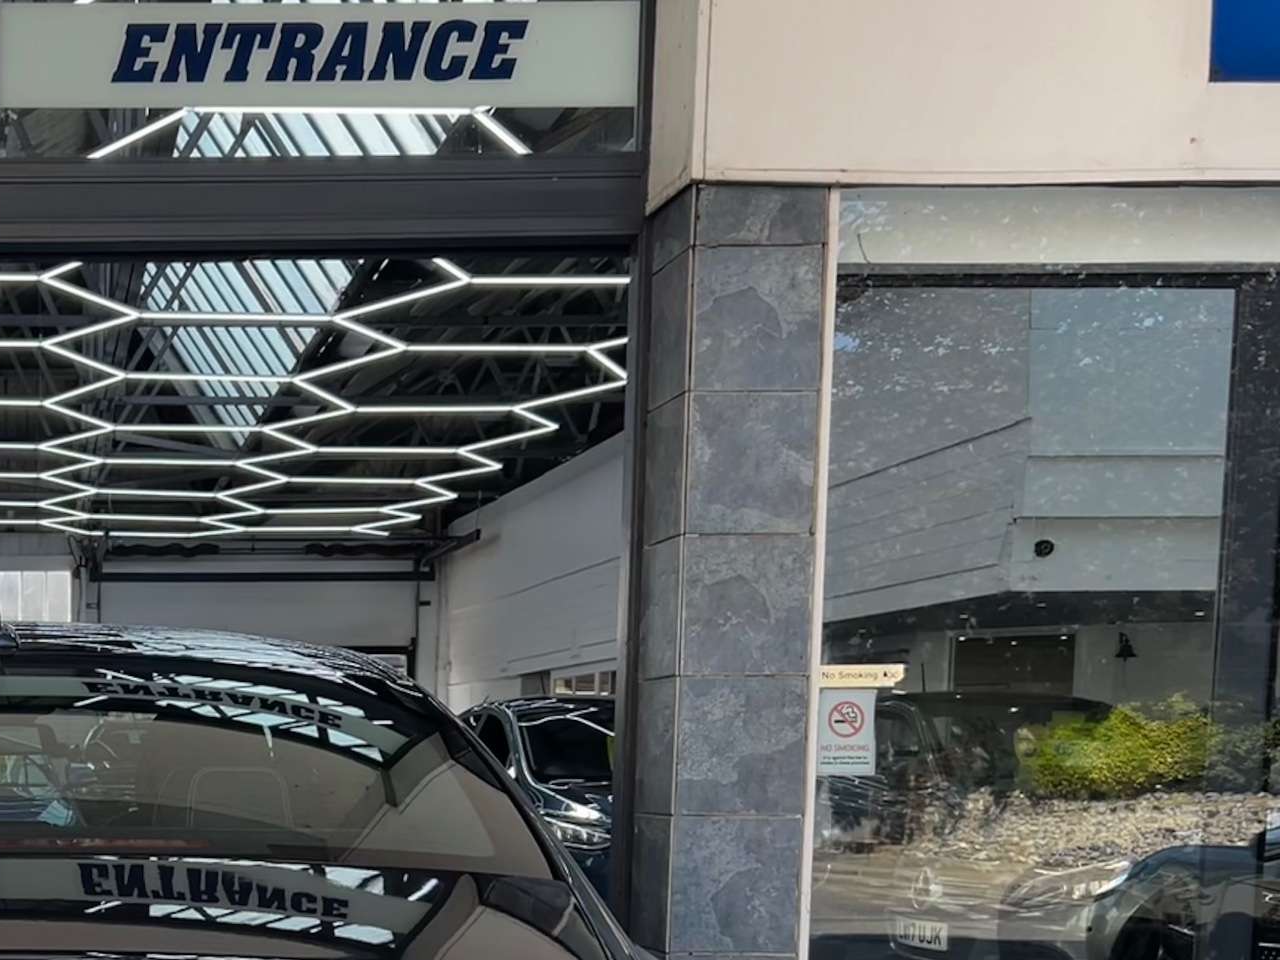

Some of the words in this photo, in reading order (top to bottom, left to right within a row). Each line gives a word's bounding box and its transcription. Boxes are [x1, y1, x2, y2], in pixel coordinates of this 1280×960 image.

[111, 20, 528, 83] ENTRANCE
[822, 672, 835, 680] No
[838, 671, 878, 681] Smoking
